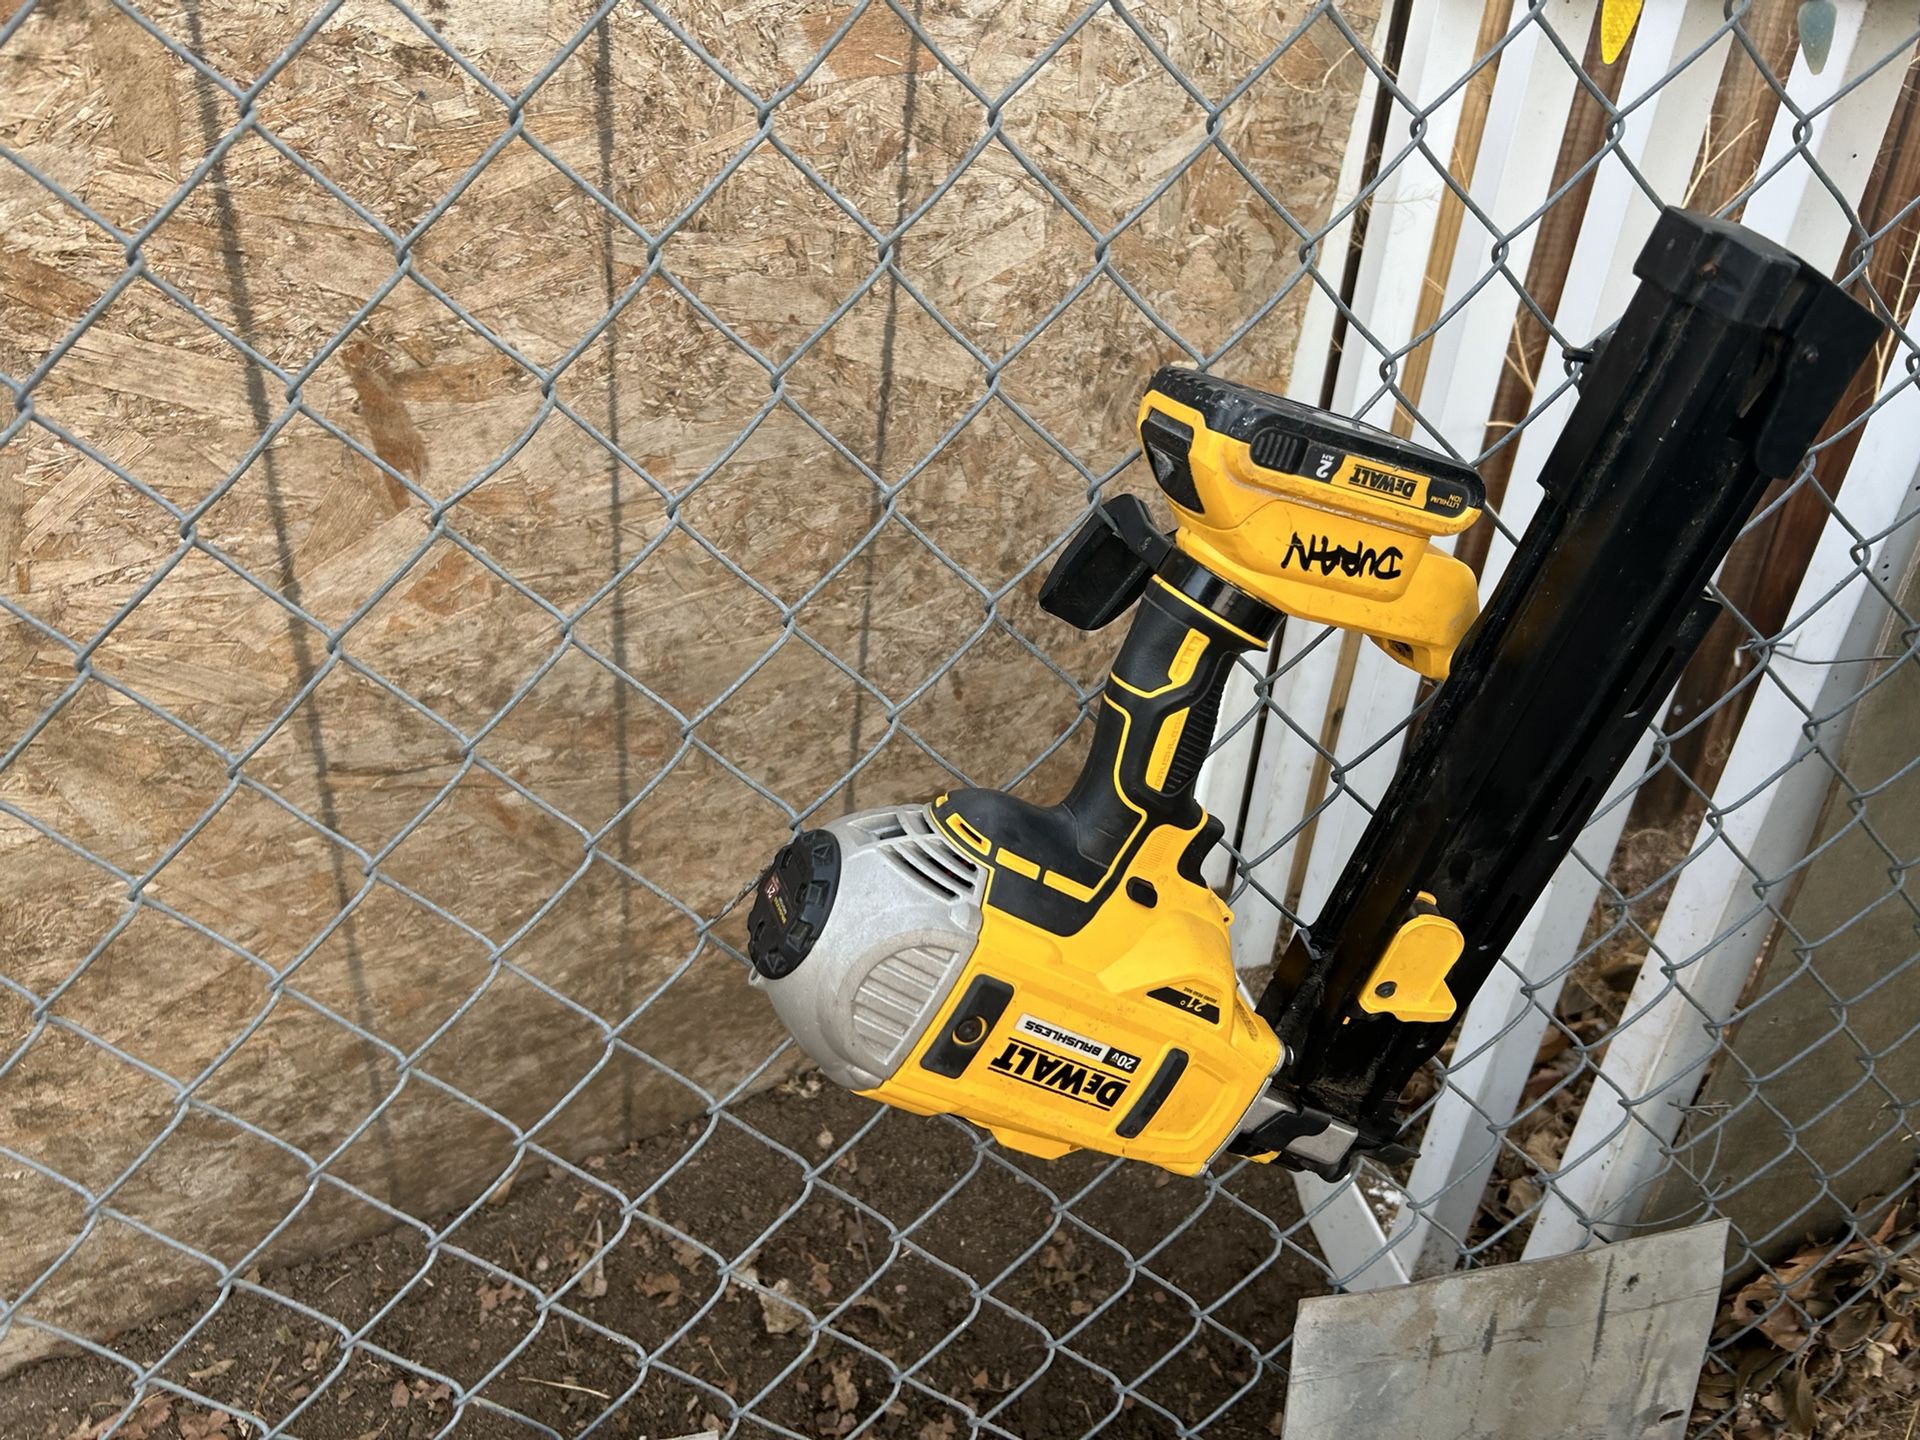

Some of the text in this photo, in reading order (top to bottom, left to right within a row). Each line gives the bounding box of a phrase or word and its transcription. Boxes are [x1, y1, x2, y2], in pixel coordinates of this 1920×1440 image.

[1316, 460, 1333, 478] 2
[1430, 496, 1460, 509] LITHIUM
[1449, 494, 1463, 503] ION
[1281, 531, 1403, 580] DURAN
[1024, 1020, 1103, 1057] BRUSHLESS
